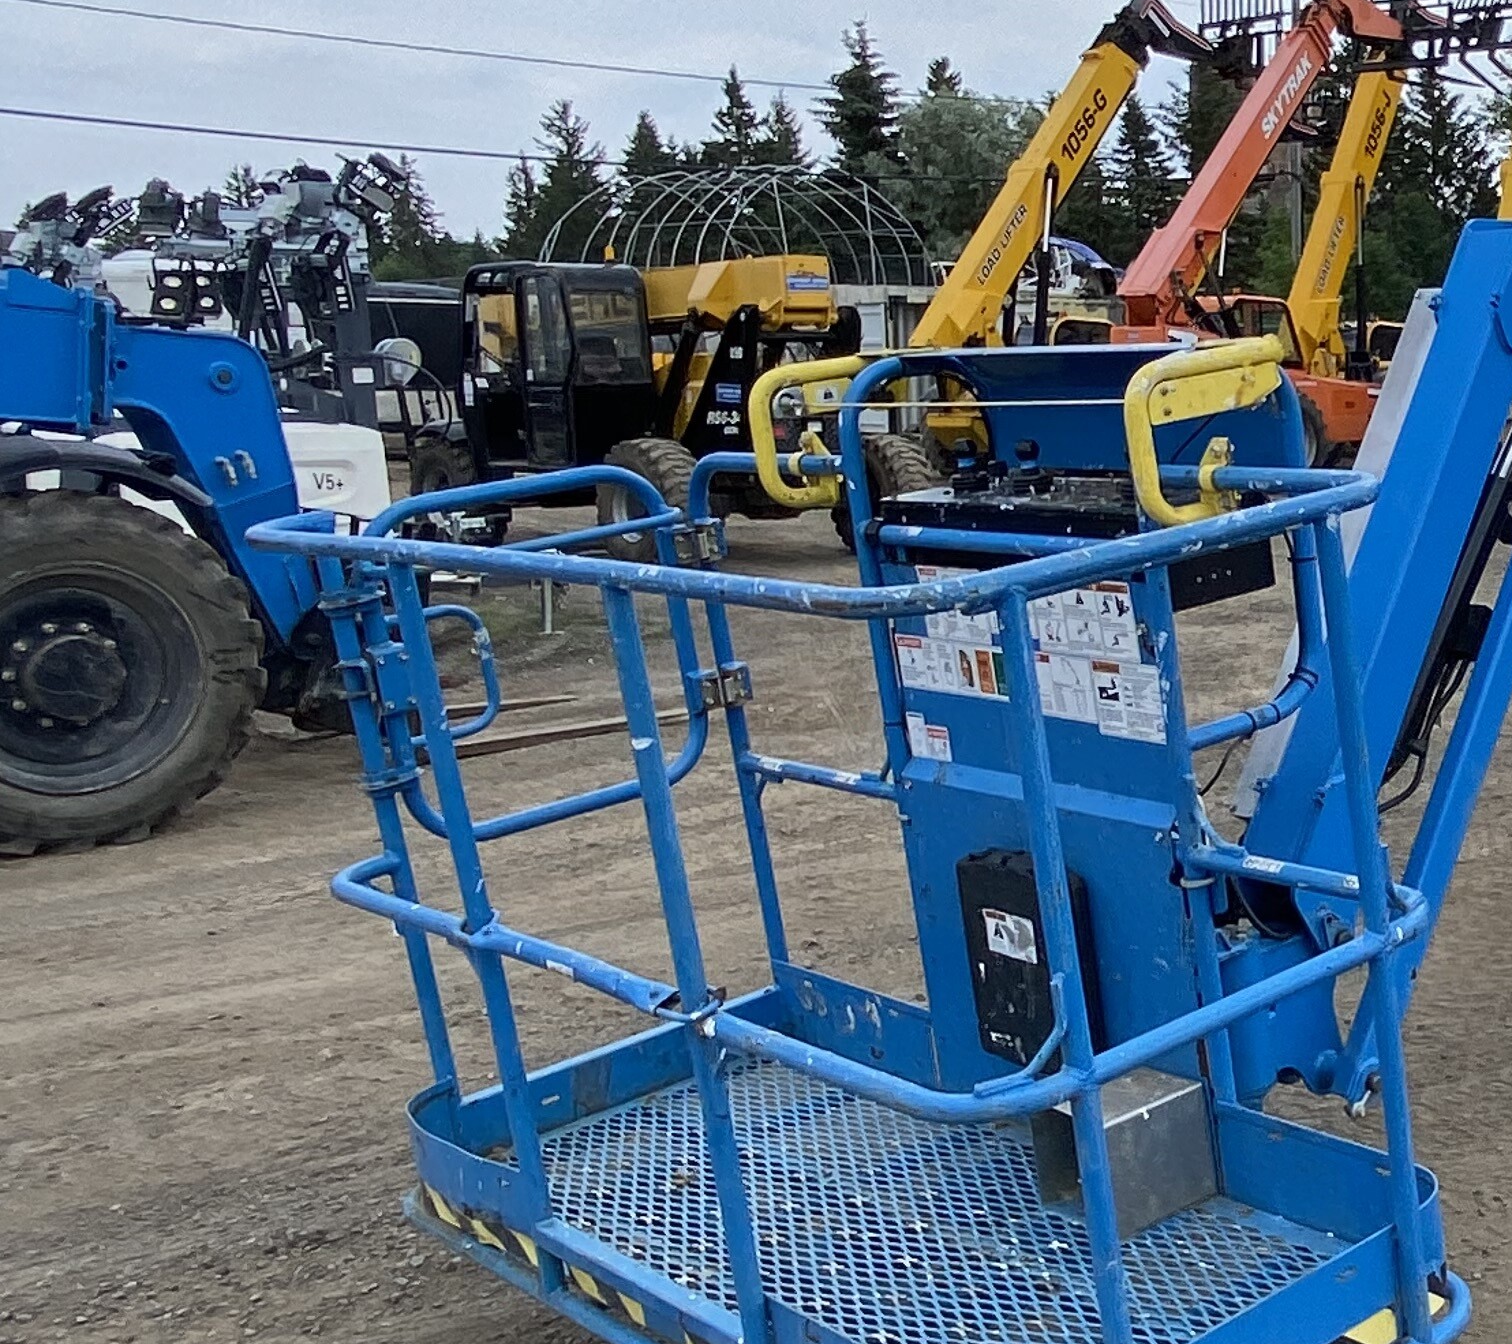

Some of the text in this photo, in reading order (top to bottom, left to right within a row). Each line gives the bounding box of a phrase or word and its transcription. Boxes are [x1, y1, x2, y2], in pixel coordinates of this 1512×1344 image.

[1061, 87, 1108, 161] 1056-G
[1261, 50, 1313, 139] SKYTRAK
[1364, 89, 1392, 158] 1056-J
[976, 203, 1028, 286] LOAD LIFTER
[312, 472, 344, 490] V5+
